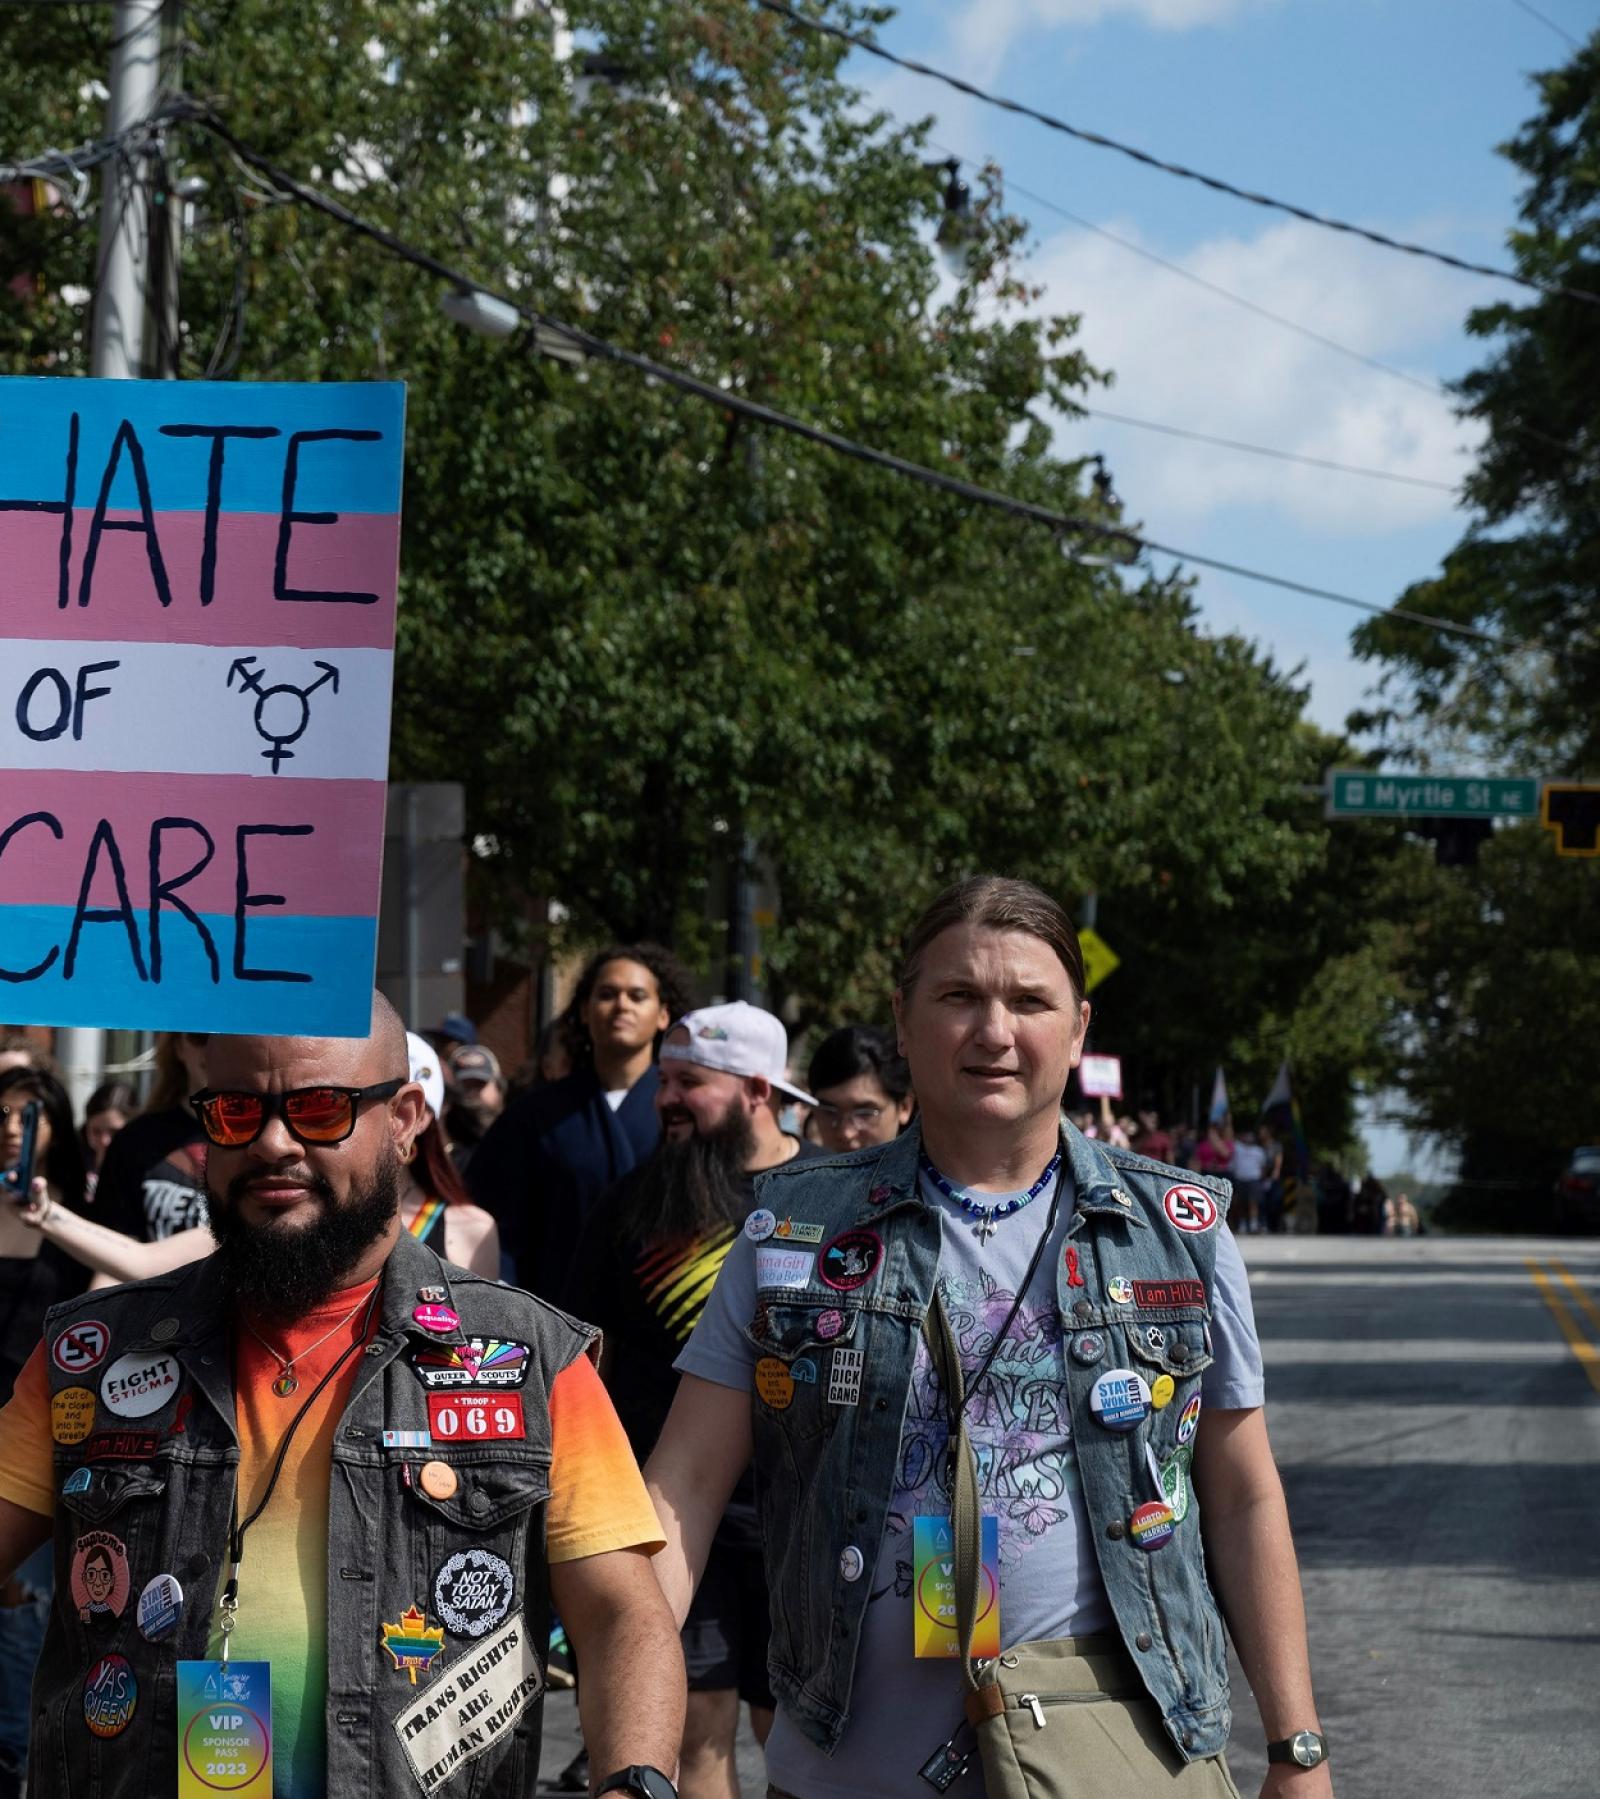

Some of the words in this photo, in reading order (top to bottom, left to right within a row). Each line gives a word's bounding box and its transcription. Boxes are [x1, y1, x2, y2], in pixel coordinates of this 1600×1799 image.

[14, 660, 121, 741] OF
[1374, 781, 1455, 808] Myrtle
[1465, 782, 1490, 809] St
[1501, 791, 1522, 808] NE
[1146, 1290, 1168, 1303] am
[1170, 1284, 1194, 1299] HIV
[950, 1311, 1050, 1363] Read
[833, 1350, 861, 1367] GIRL
[107, 1359, 170, 1394] FIGHT
[434, 1371, 467, 1381] QUEER
[480, 1369, 517, 1379] SCOUTS
[831, 1368, 861, 1386] DICK
[63, 1391, 79, 1400] out
[110, 1374, 174, 1404] STIGMA
[829, 1385, 858, 1404] GANG
[1098, 1379, 1129, 1398] STAY
[1127, 1376, 1142, 1405] VOTE
[460, 1397, 489, 1405] TROOP
[1101, 1394, 1131, 1409] WOKE
[64, 1411, 82, 1420] and
[437, 1408, 516, 1435] 069
[55, 1421, 72, 1431] into
[73, 1421, 87, 1430] the
[57, 1431, 87, 1441] streets
[112, 1434, 143, 1454] HIV
[1140, 1522, 1171, 1540] WARREN
[458, 1571, 494, 1585] NOT
[160, 1578, 173, 1609] VOTE
[451, 1584, 501, 1598] TODAY
[450, 1596, 498, 1610] SATAN
[938, 1604, 957, 1616] 20
[94, 1660, 128, 1700] YAS
[402, 1685, 458, 1742] TRANS
[456, 1630, 519, 1693] RIGHTS
[84, 1690, 130, 1727] QUEEN
[457, 1689, 495, 1728] ARE
[209, 1715, 244, 1731] VIP
[420, 1727, 485, 1789] HUMAN
[484, 1673, 538, 1737] RIGHTS
[202, 1737, 251, 1747] SPONSOR
[214, 1748, 239, 1758] PASS
[206, 1763, 248, 1776] 2023
